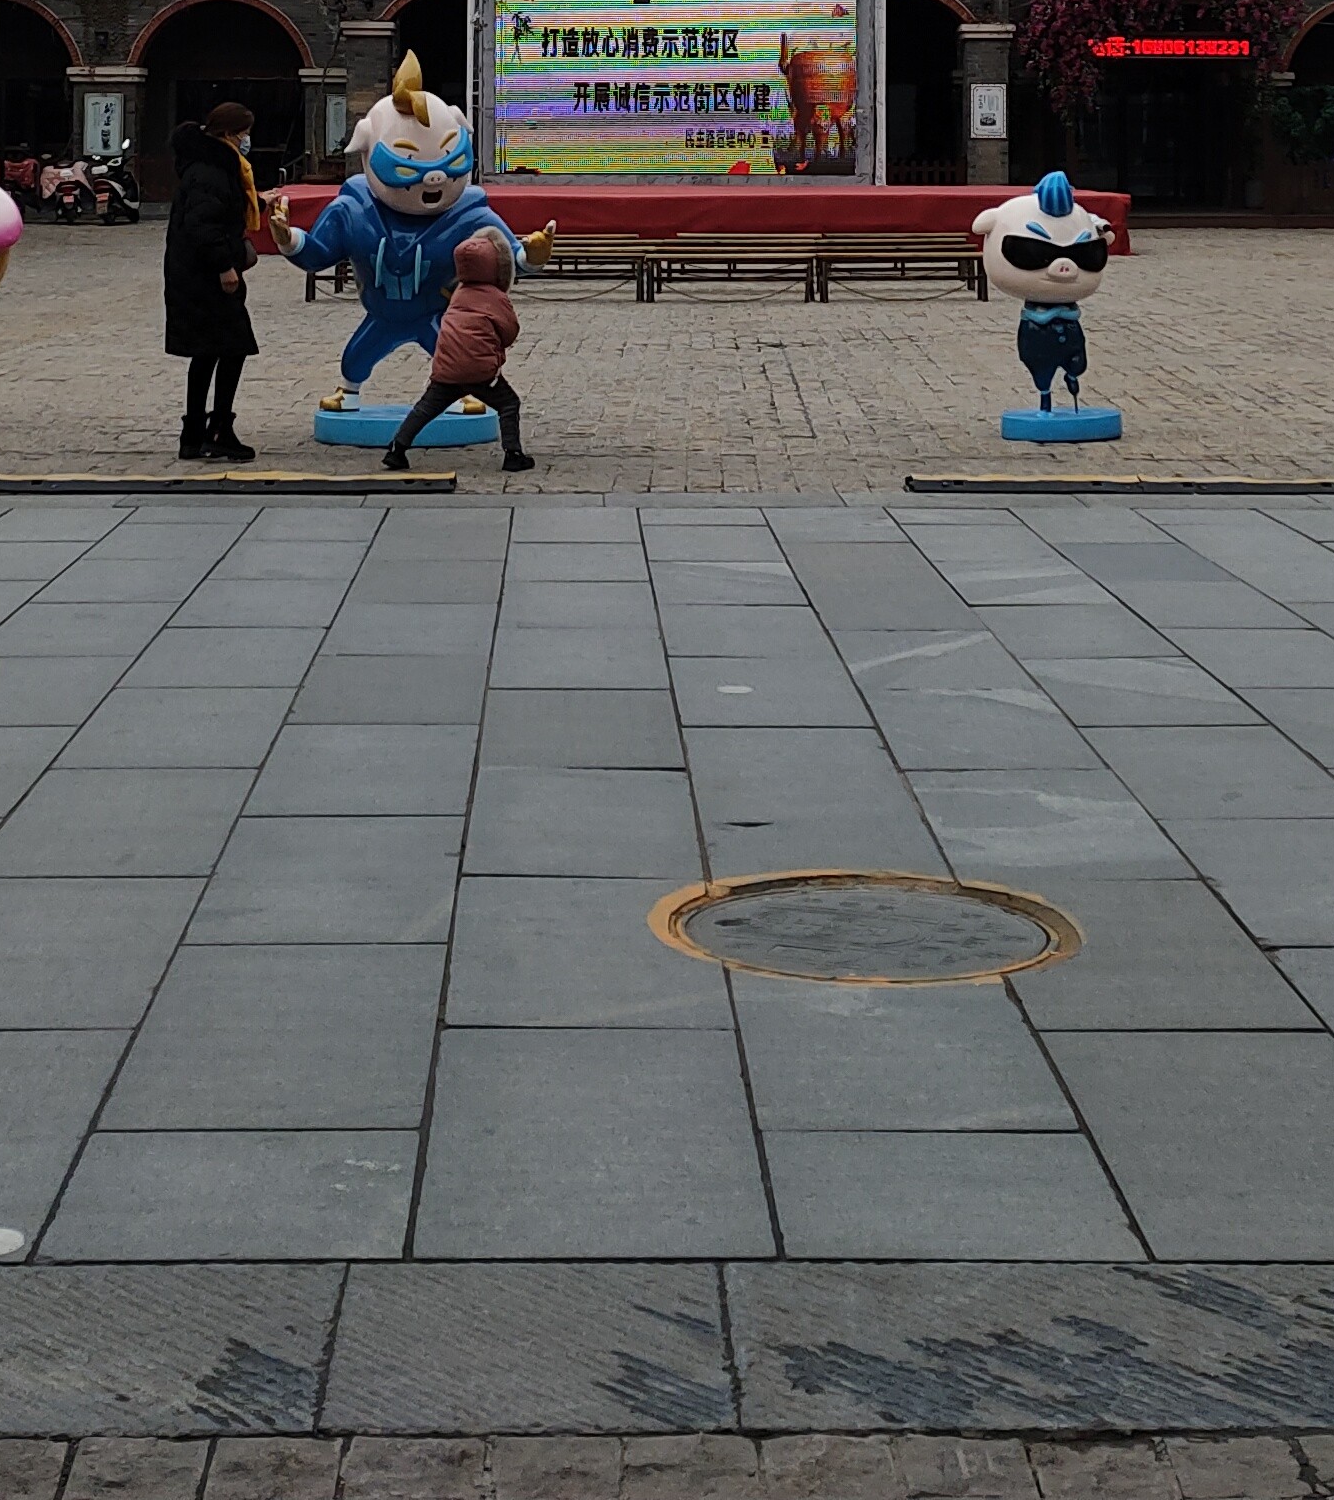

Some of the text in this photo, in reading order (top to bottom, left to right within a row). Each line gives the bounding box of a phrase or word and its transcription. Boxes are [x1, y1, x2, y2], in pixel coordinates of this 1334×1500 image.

[542, 27, 740, 58] 打造放心消费示范街区
[573, 82, 772, 114] 开展诚信示范街区创建
